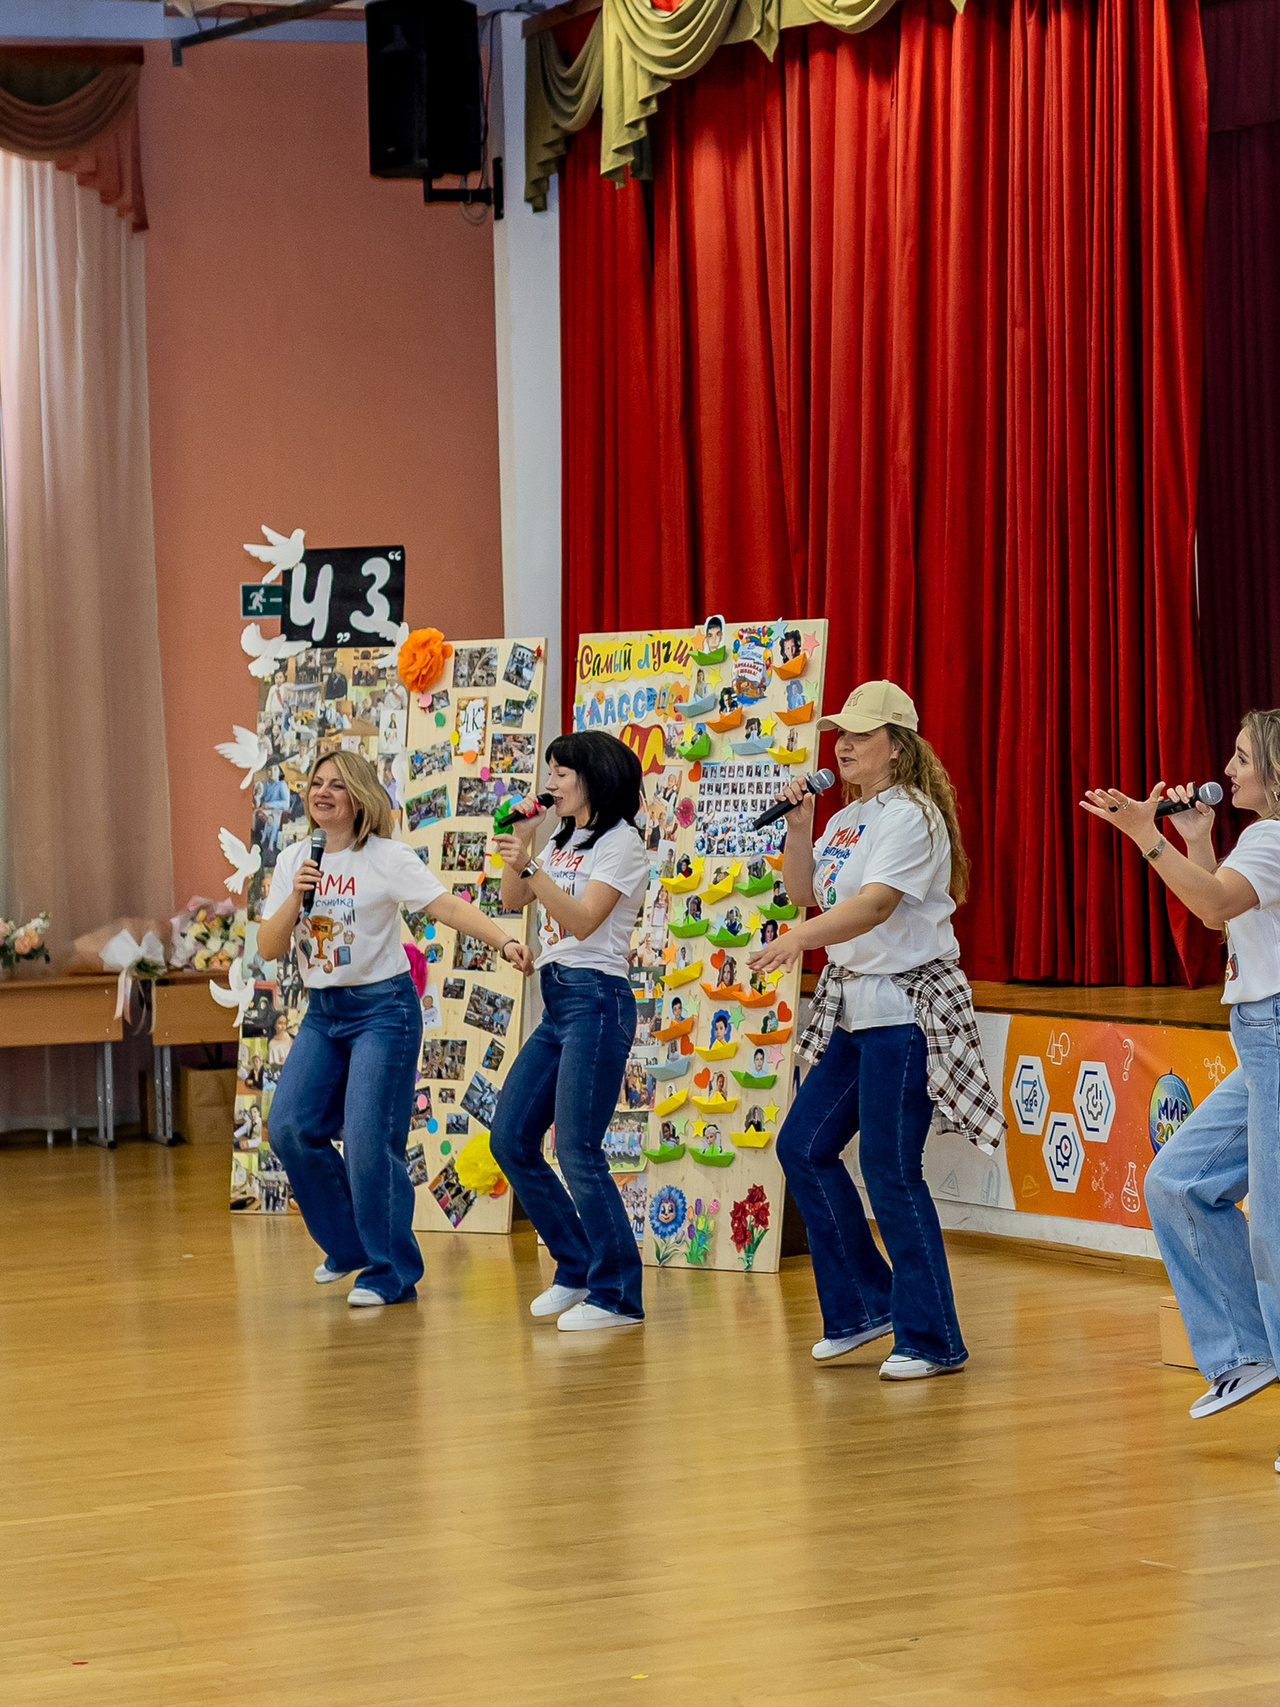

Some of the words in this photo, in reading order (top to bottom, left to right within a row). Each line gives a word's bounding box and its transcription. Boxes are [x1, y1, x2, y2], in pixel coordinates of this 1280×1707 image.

[580, 642, 633, 680] Самый
[314, 874, 356, 896] АМА
[315, 898, 354, 908] скника
[1157, 1097, 1188, 1122] МИР
